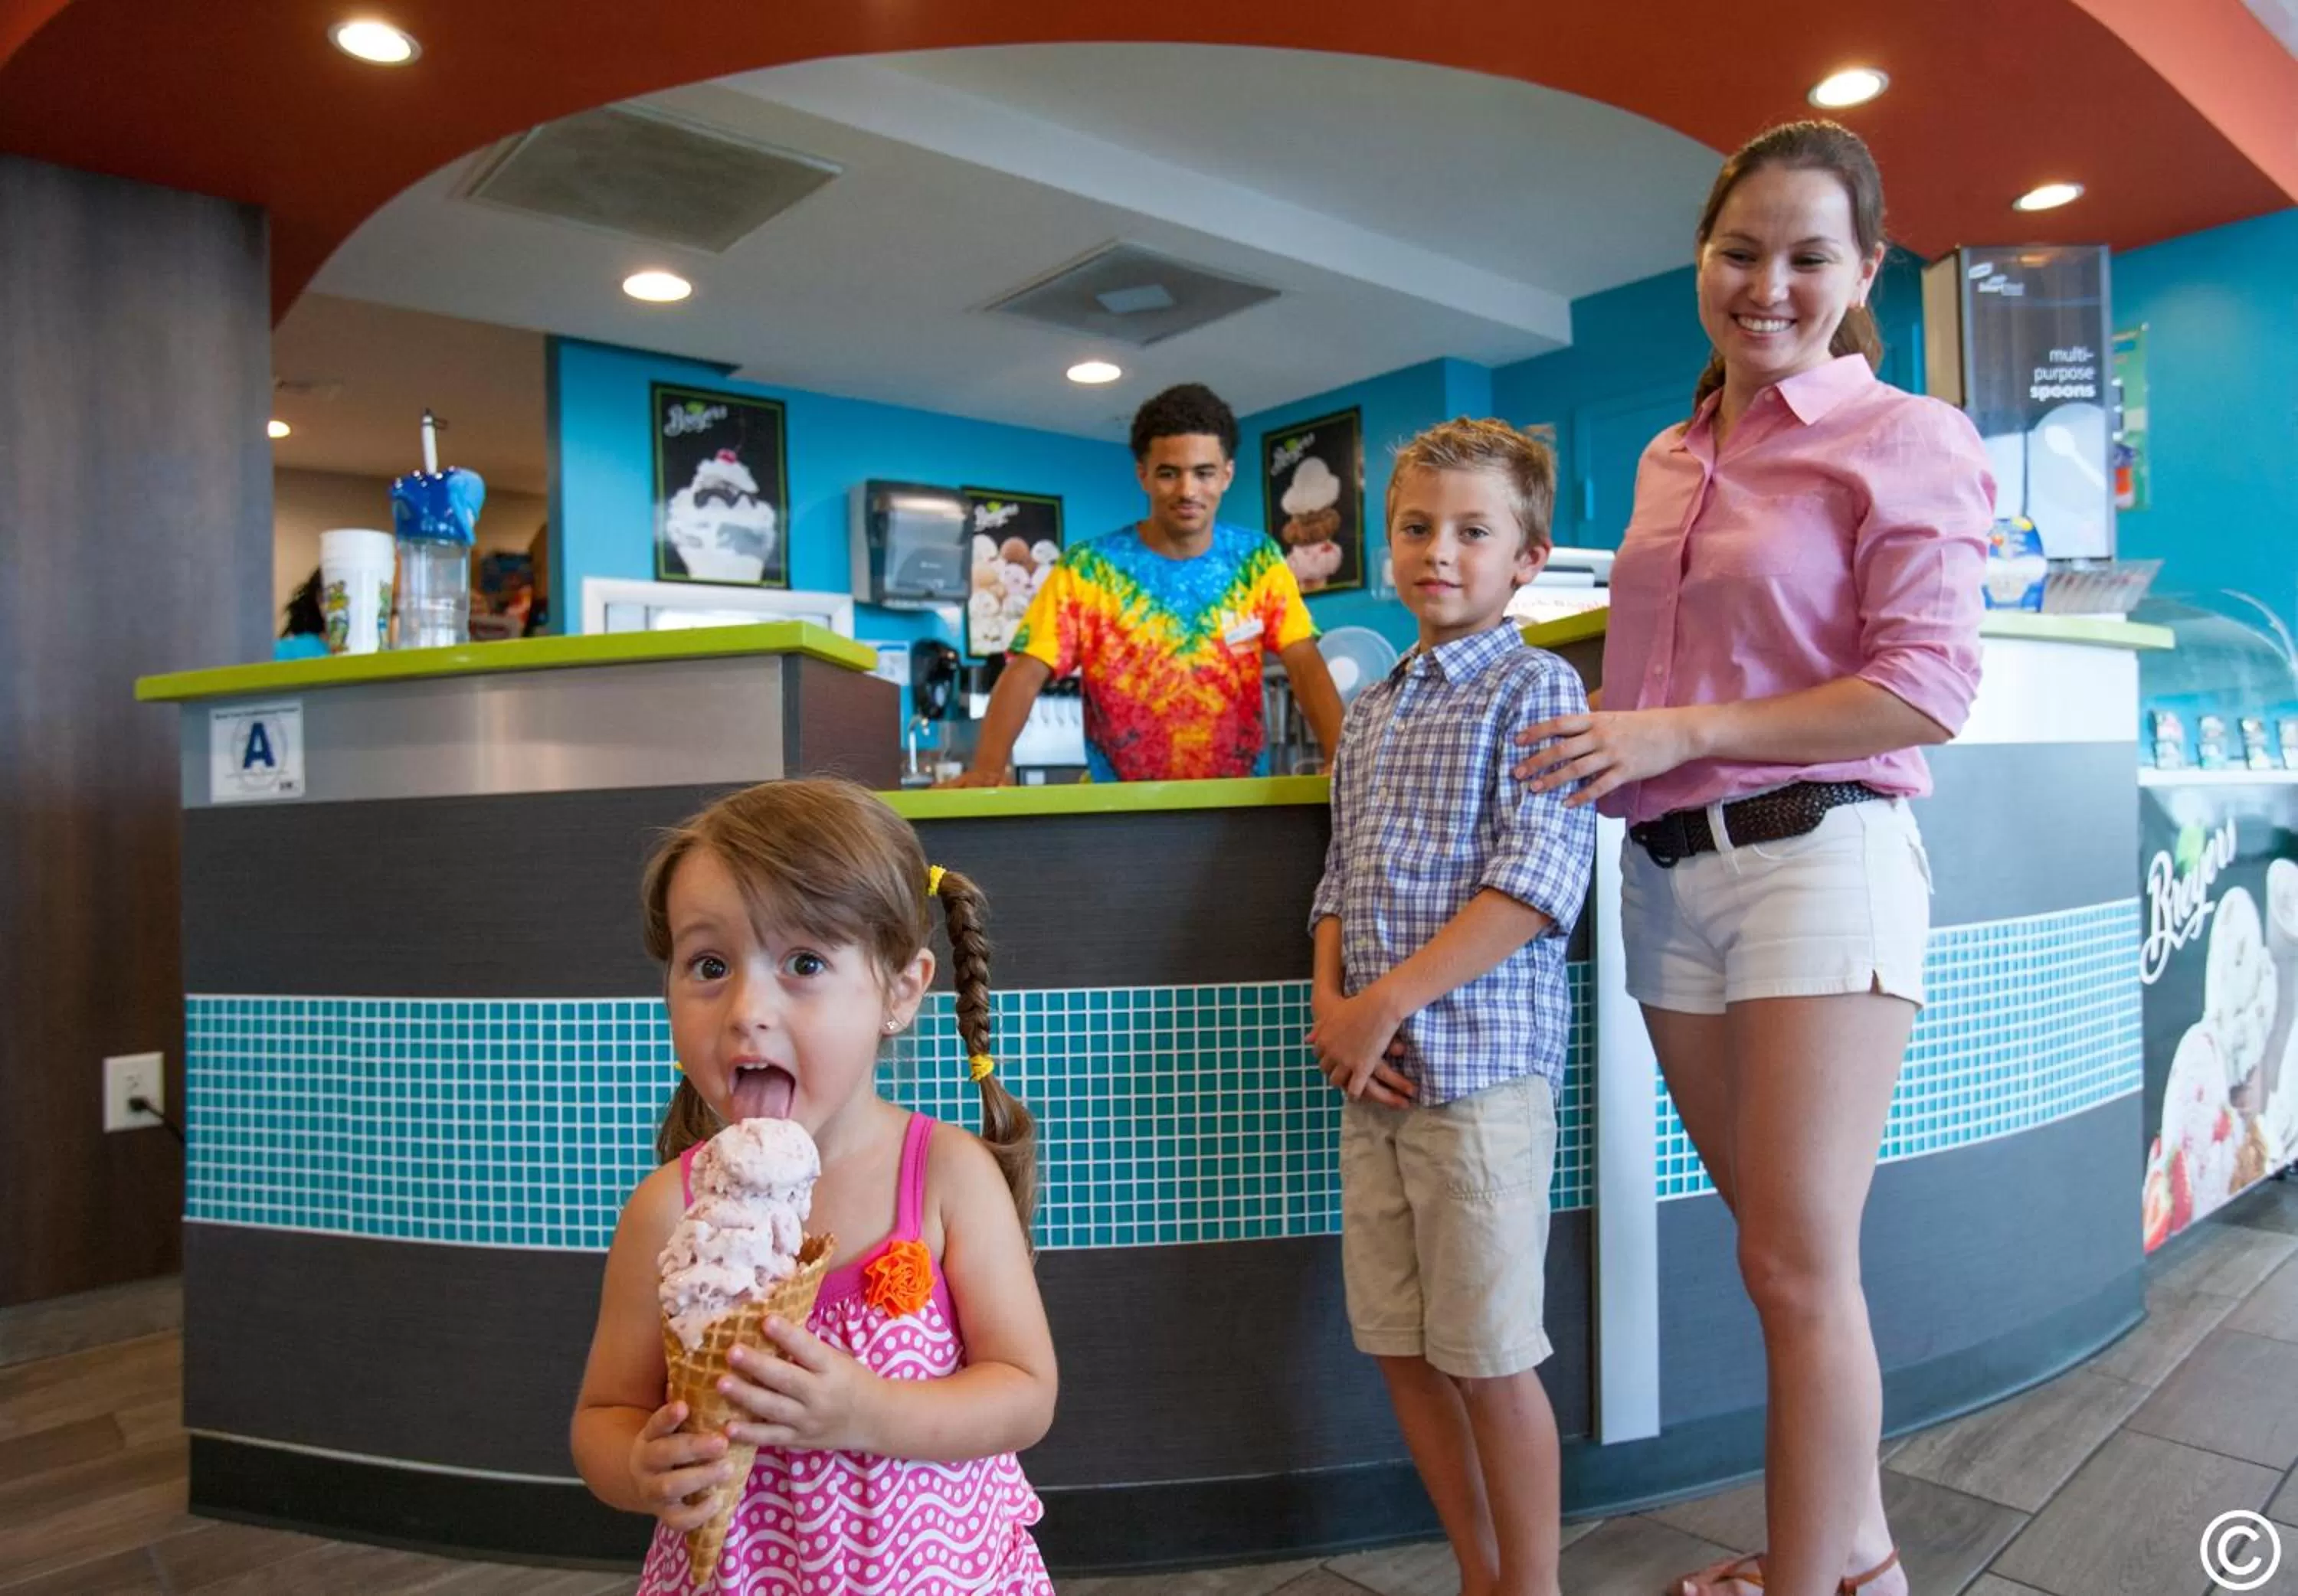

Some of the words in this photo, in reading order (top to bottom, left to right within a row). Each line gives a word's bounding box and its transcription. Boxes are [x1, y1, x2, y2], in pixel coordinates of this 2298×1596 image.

[2049, 346, 2094, 362] multi-
[2034, 368, 2095, 384] purpose
[2029, 384, 2096, 402] spoons
[243, 722, 275, 770] A
[2140, 817, 2237, 985] Breyers
